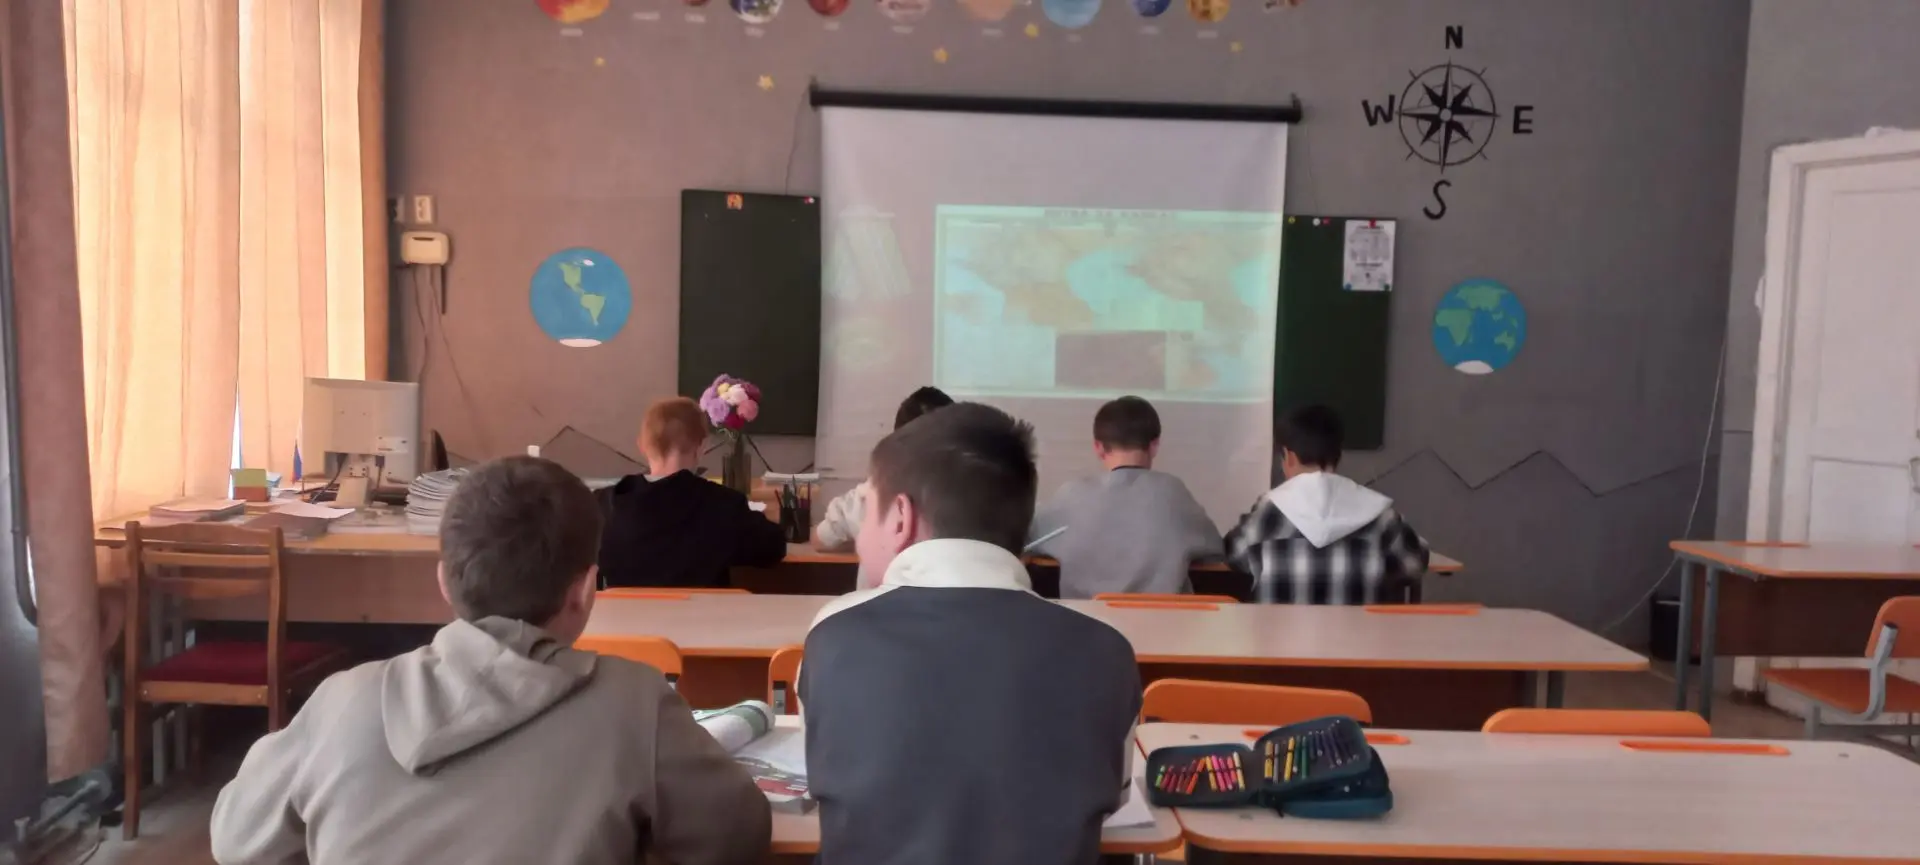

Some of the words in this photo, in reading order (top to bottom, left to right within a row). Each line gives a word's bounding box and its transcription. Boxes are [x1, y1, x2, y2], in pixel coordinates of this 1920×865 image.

[1445, 25, 1464, 50] N
[1361, 94, 1396, 127] W
[1512, 105, 1534, 134] E
[1422, 179, 1452, 221] S
